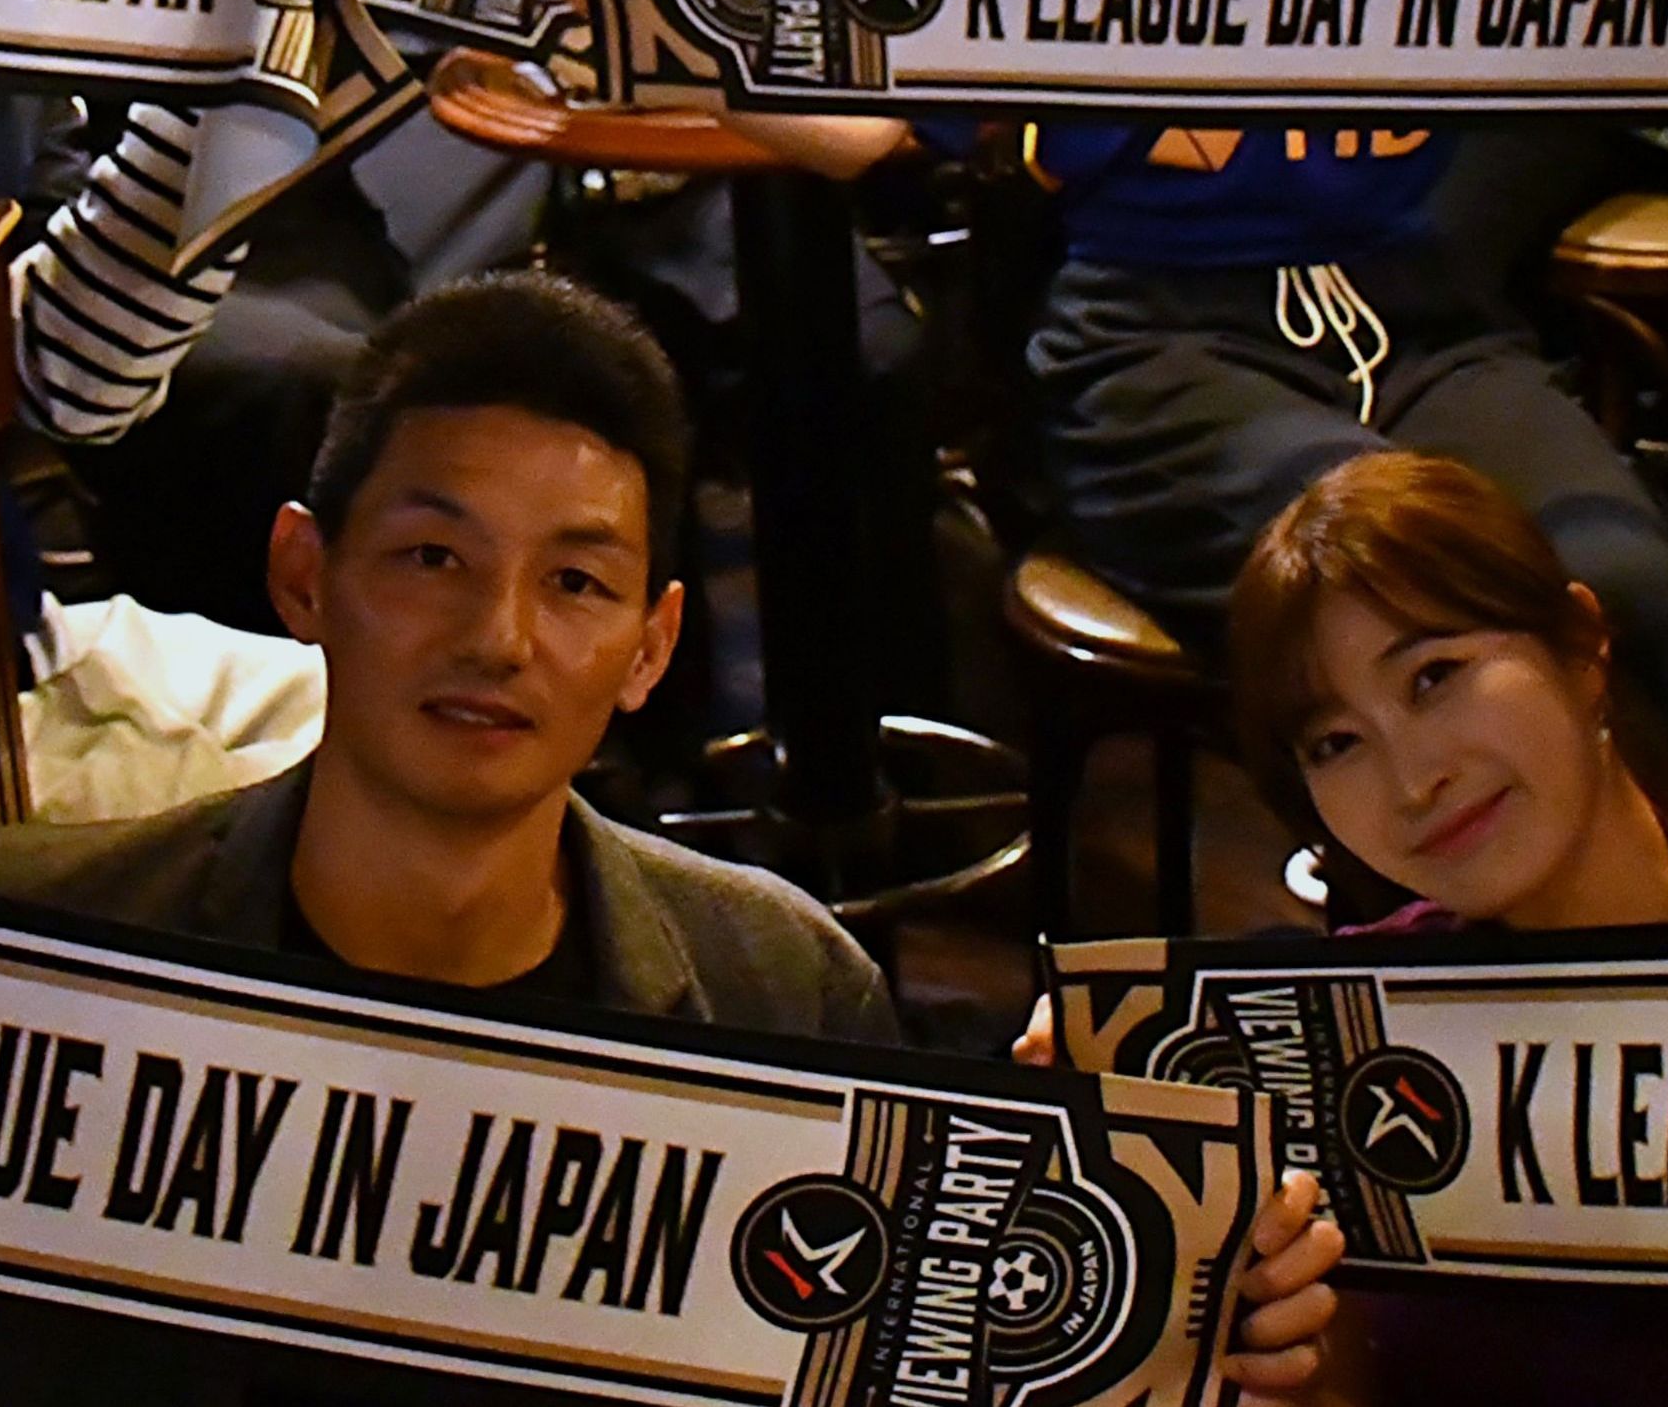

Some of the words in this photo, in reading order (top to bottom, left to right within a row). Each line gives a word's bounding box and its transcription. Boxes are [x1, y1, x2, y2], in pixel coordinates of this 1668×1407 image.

[102, 1051, 301, 1244] DAY
[290, 1085, 415, 1267] IN
[409, 1109, 726, 1317] JAPAN
[926, 1113, 1033, 1249] PARTY
[1497, 1041, 1557, 1206] K
[871, 1163, 935, 1372] INTERNATIONAL
[1060, 1307, 1087, 1337] IN
[1077, 1238, 1102, 1312] JAPAN
